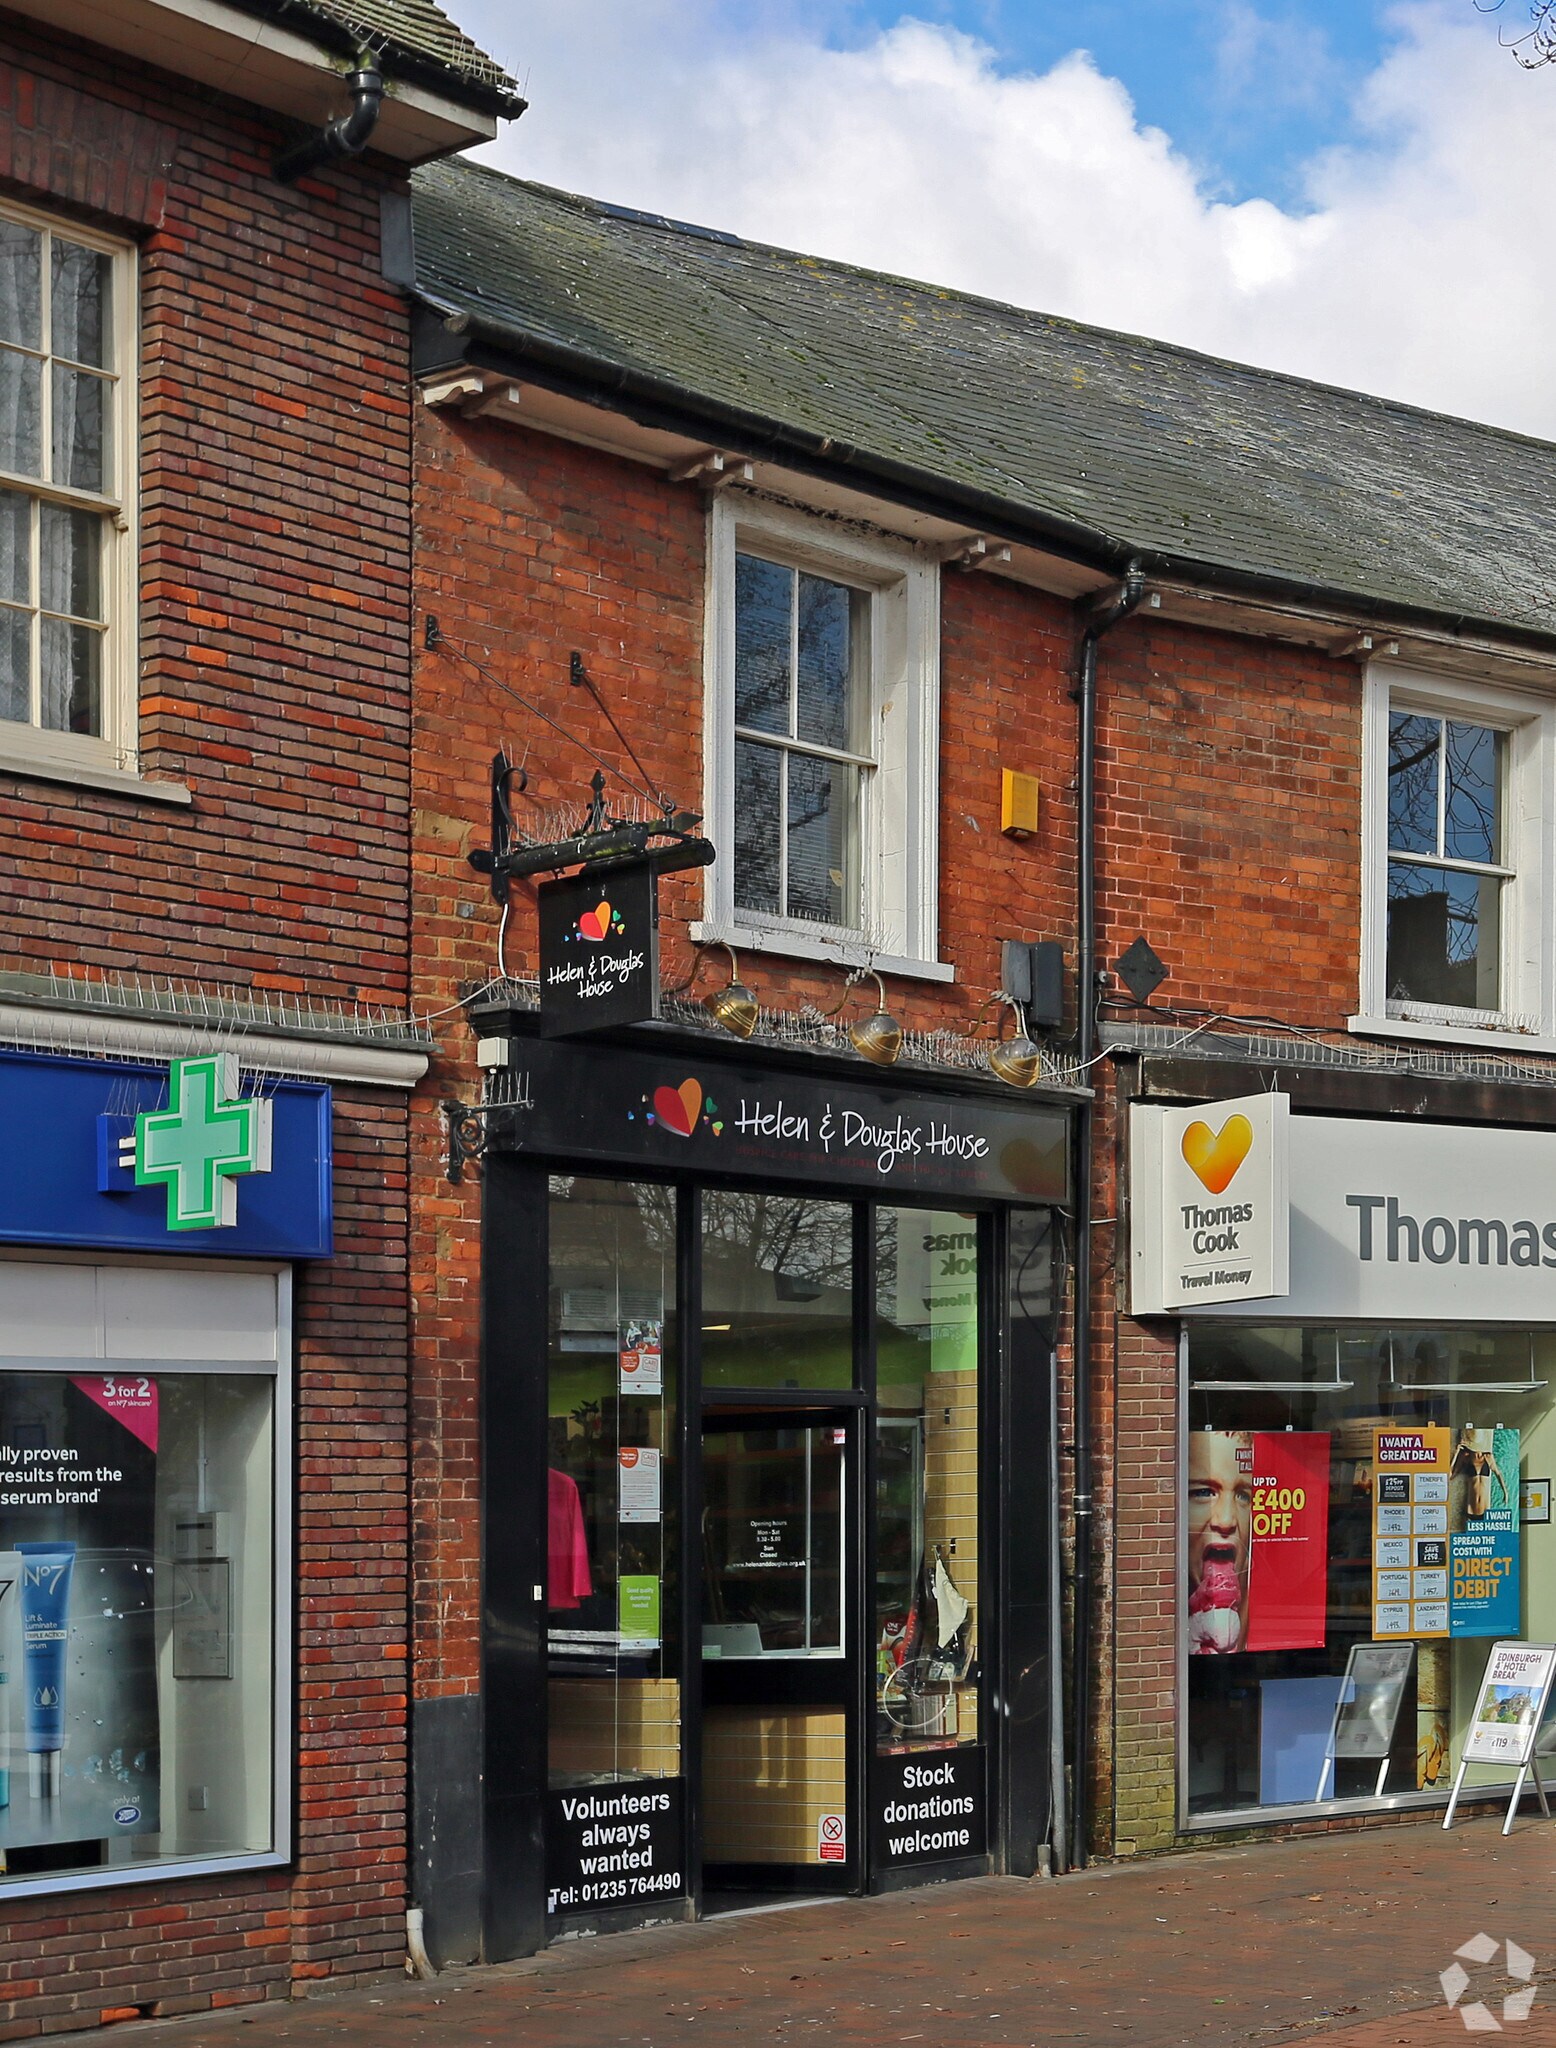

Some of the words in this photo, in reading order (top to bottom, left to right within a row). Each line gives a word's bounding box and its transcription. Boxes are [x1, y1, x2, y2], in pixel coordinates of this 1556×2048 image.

[547, 962, 584, 985] Helen
[588, 956, 597, 981] &
[600, 949, 644, 983] Douglas
[577, 980, 614, 998] House
[735, 1099, 809, 1142] Helen
[819, 1103, 836, 1153] &
[842, 1115, 921, 1174] Douglas
[925, 1121, 990, 1160] House
[1180, 1203, 1253, 1230] Thomas
[1192, 1226, 1240, 1254] Cook
[1346, 1194, 1556, 1268] Thomas
[1180, 1271, 1213, 1289] Travel
[1214, 1270, 1253, 1285] Money
[102, 1377, 116, 1397] 3
[118, 1385, 136, 1397] for
[136, 1377, 151, 1397] 2
[1380, 1438, 1384, 1448] I
[1385, 1438, 1413, 1448] WANT
[1414, 1438, 1422, 1448] A
[0, 1446, 20, 1465] lly
[23, 1449, 78, 1464] proven
[1380, 1450, 1412, 1460] GREAT
[1412, 1450, 1436, 1460] DEAL
[0, 1467, 54, 1482] results
[57, 1467, 92, 1482] from
[95, 1467, 122, 1482] the
[1253, 1478, 1265, 1486] UP
[1265, 1477, 1277, 1486] TO
[1, 1492, 52, 1504] serum
[1252, 1488, 1306, 1510] £400
[1253, 1513, 1292, 1536] OFF
[1490, 1511, 1511, 1520] WANT
[1468, 1522, 1484, 1532] LESS
[1485, 1522, 1511, 1531] HASSLE
[1453, 1536, 1481, 1545] SPREAD
[1482, 1536, 1495, 1544] THE
[1453, 1548, 1473, 1556] COST
[1474, 1547, 1492, 1556] WITH
[1454, 1557, 1512, 1578] DIRECT
[1454, 1579, 1500, 1599] DEBIT
[25, 1614, 36, 1622] Lift
[37, 1614, 43, 1622] &
[25, 1622, 57, 1630] Luminate
[26, 1632, 44, 1640] TRIPLE
[44, 1631, 65, 1639] ACTION
[26, 1642, 47, 1650] Serum
[1497, 1652, 1542, 1663] EDINBURGH
[1492, 1670, 1517, 1680] BREAK
[1504, 1662, 1526, 1672] HOTEL
[1491, 1737, 1508, 1748] £119
[903, 1762, 955, 1788] Stock
[114, 1795, 130, 1806] only
[132, 1795, 140, 1803] at
[561, 1794, 671, 1821] Volunteers
[883, 1795, 974, 1824] donations
[581, 1823, 651, 1847] always
[888, 1829, 970, 1855] welcome
[580, 1845, 653, 1875] wanted
[550, 1888, 579, 1906] Tel:
[582, 1880, 627, 1901] 01235
[629, 1872, 681, 1895] 764490
